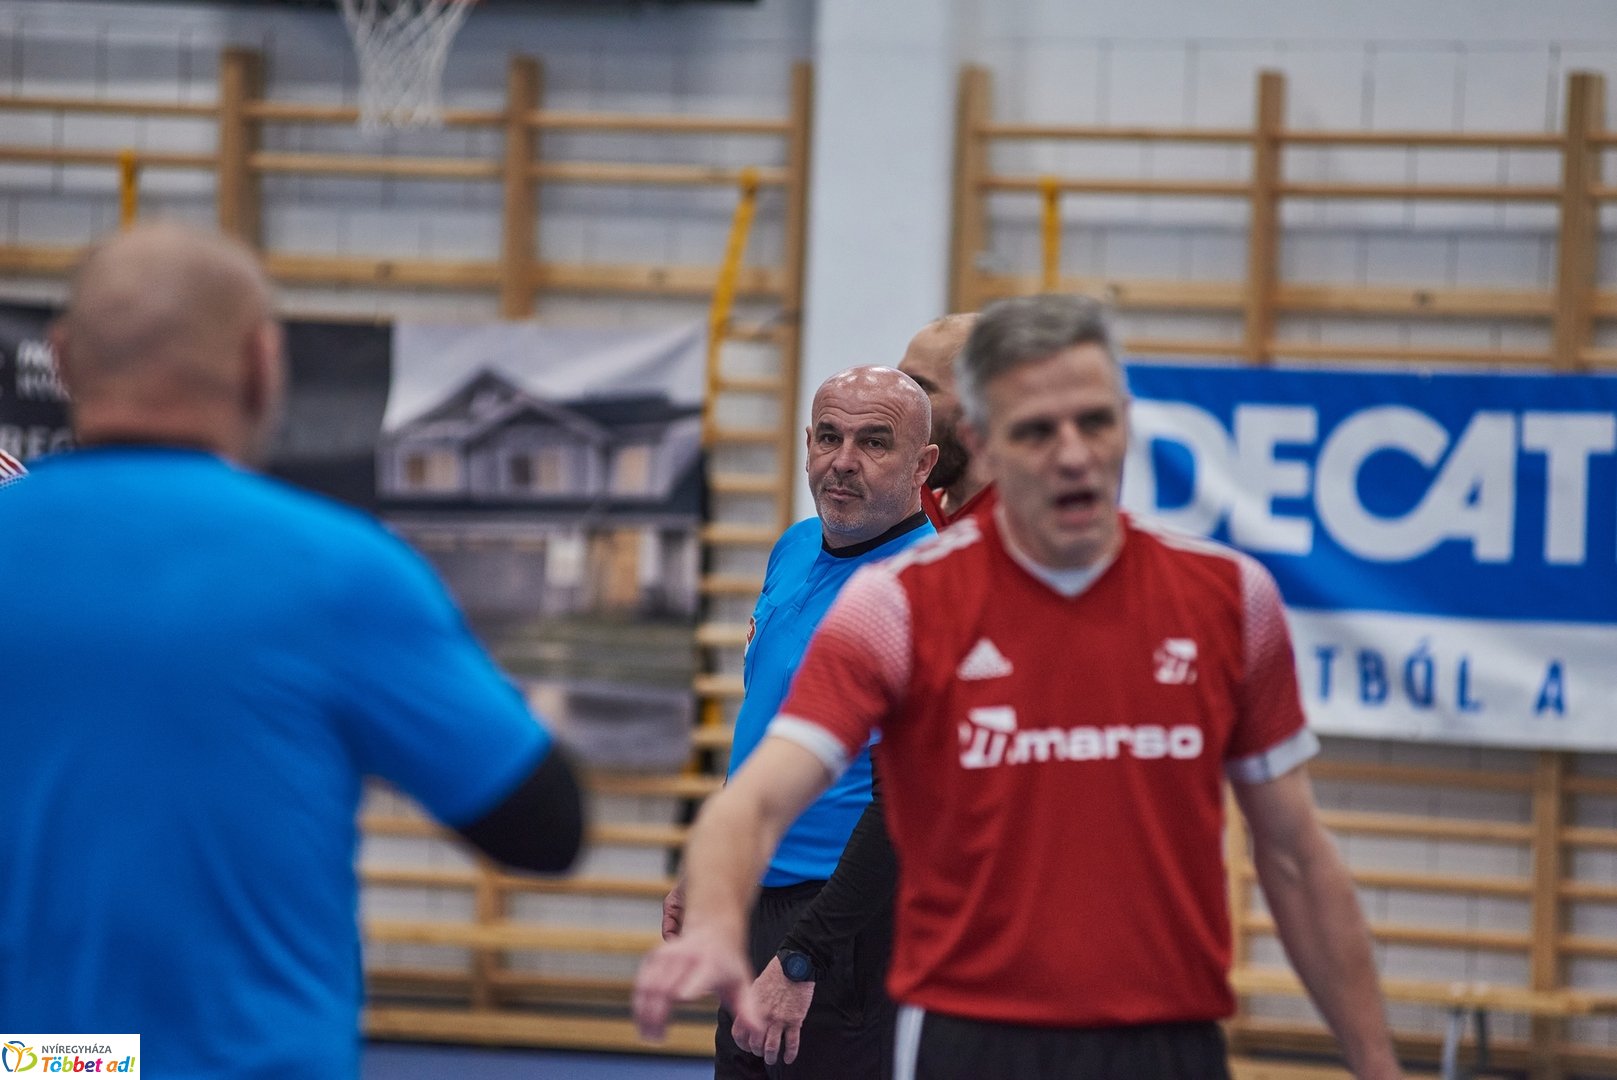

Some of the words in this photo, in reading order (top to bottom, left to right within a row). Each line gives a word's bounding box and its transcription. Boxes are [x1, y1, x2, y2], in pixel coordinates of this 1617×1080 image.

[1121, 399, 1617, 566] DECAT
[1313, 635, 1484, 714] TBÓL
[1532, 658, 1568, 717] A
[1011, 724, 1204, 764] marso
